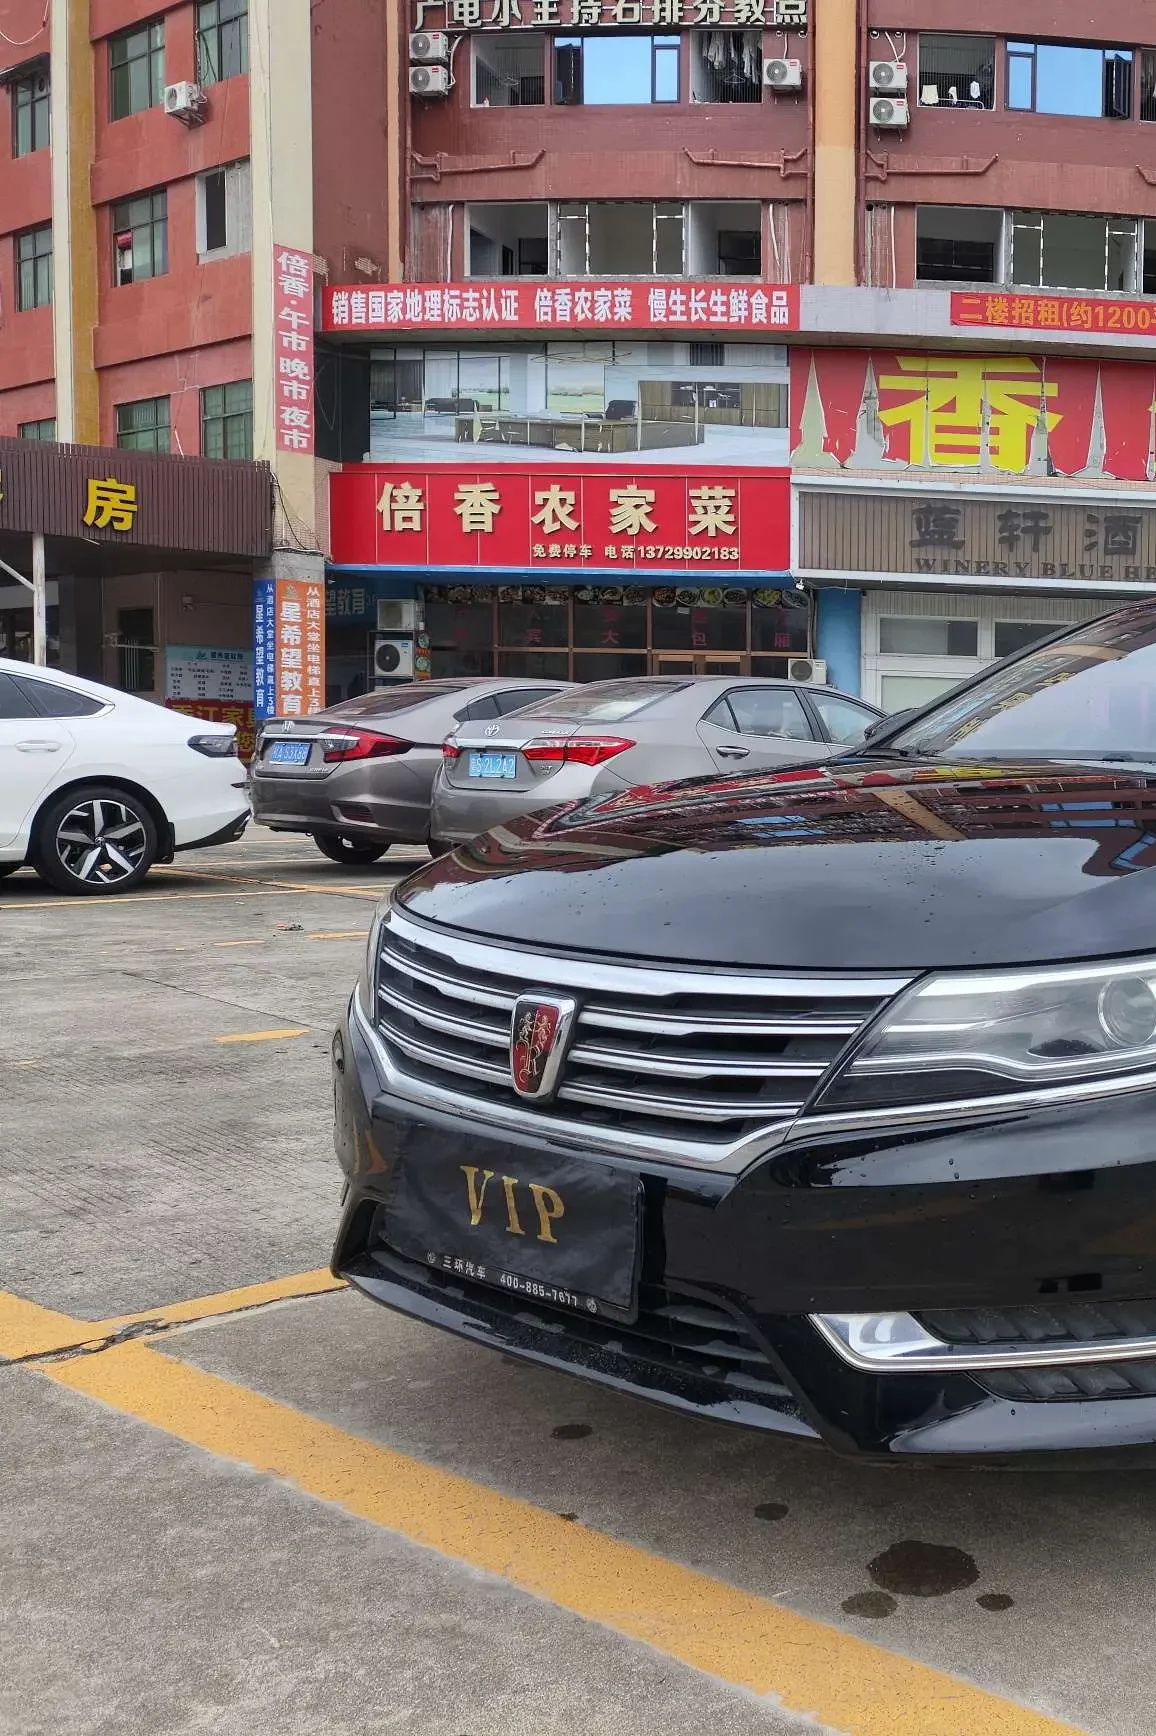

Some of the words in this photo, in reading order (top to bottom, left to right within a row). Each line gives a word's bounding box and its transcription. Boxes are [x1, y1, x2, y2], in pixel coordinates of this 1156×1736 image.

[332, 290, 519, 325] 销售国家地理标志认证
[534, 287, 632, 323] 倍香农家菜
[648, 287, 789, 325] 慢生长生鲜食品
[83, 476, 138, 531] 房
[376, 481, 738, 537] 倍香农家菜
[532, 543, 593, 559] 免费停车
[913, 557, 1032, 579] WINERY
[1039, 561, 1114, 580] BLUE
[280, 601, 303, 715] 星希望教育
[459, 1164, 565, 1243] VIP
[442, 1254, 486, 1279] 三环汽车
